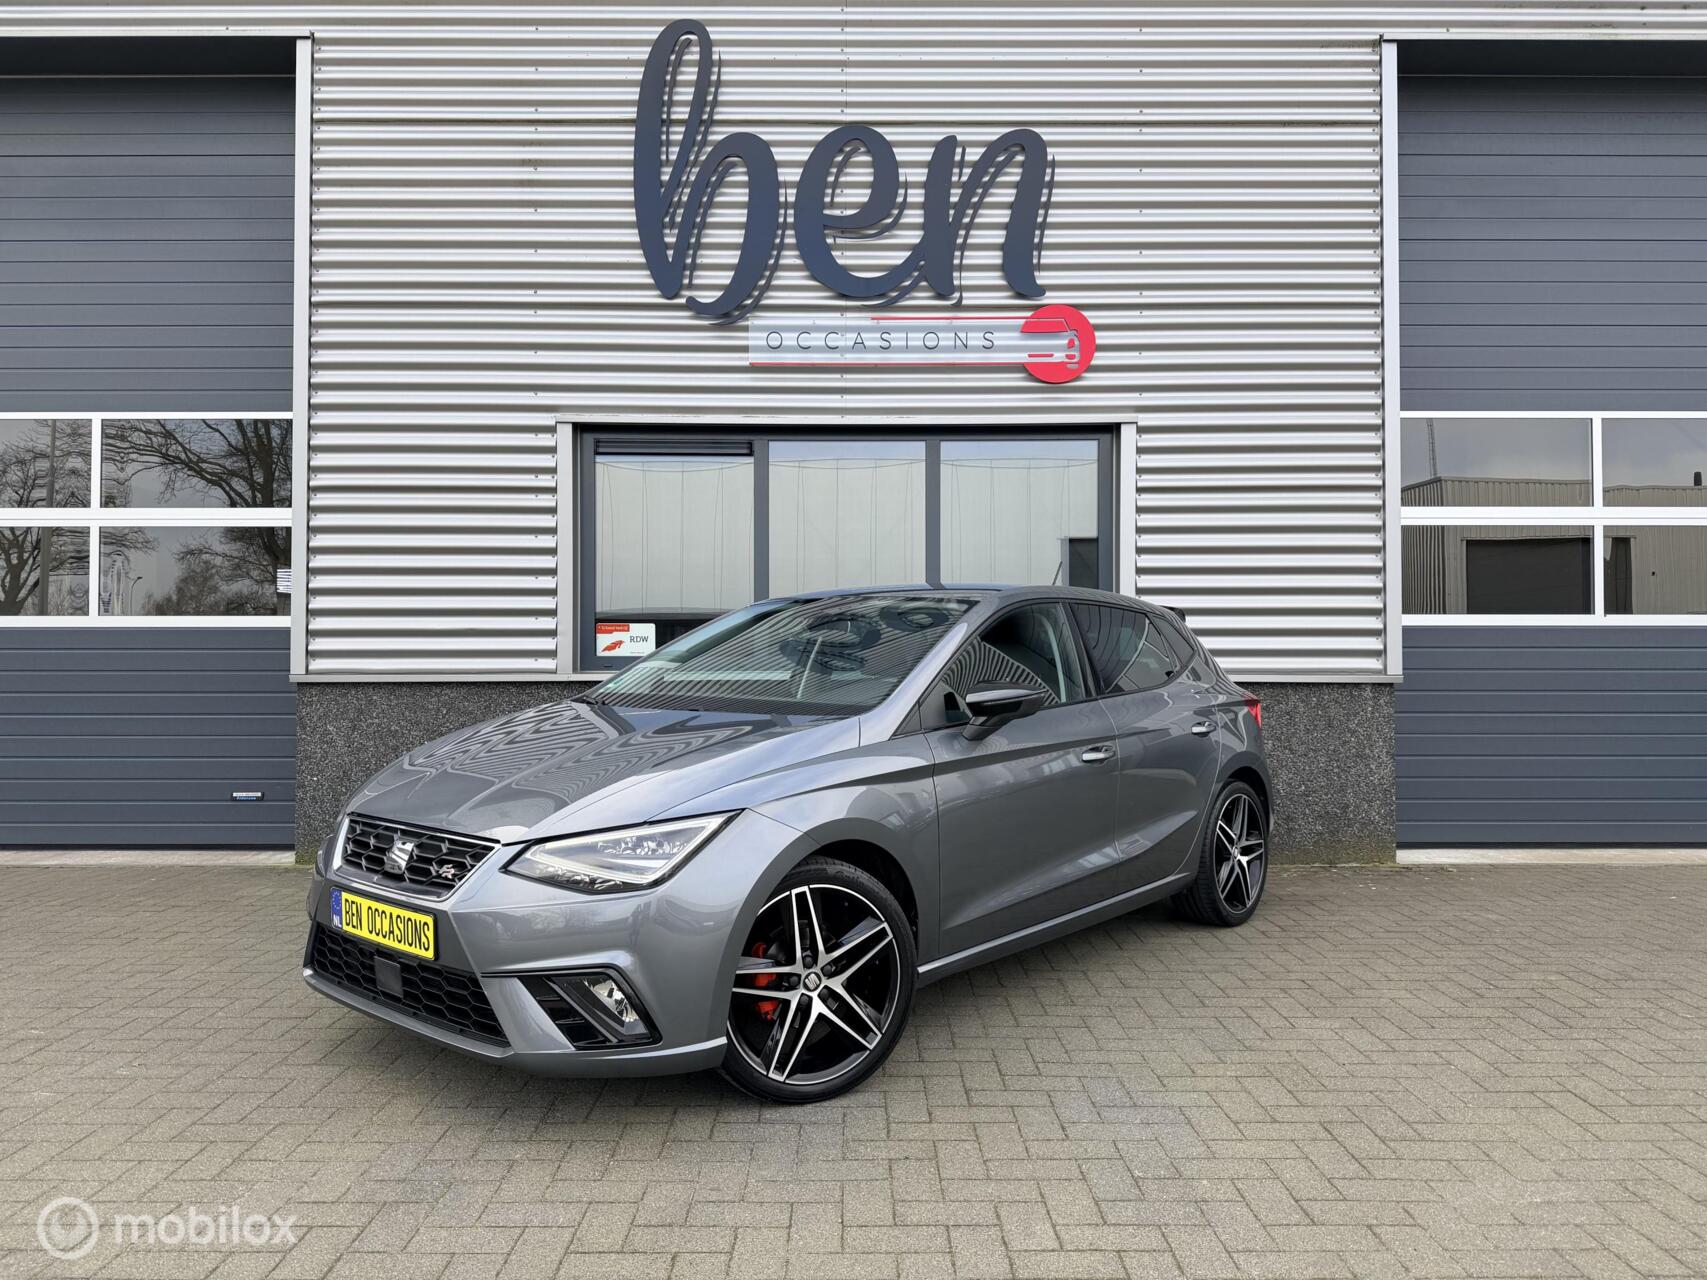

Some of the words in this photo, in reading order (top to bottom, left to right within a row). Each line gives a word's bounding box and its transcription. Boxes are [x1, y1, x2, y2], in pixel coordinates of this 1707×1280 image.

[634, 19, 1055, 325] ben
[766, 331, 995, 350] OCCASIONS
[630, 635, 648, 643] RDW
[333, 914, 342, 928] NL
[345, 899, 362, 931] BEN
[367, 906, 430, 952] OCCASIONS
